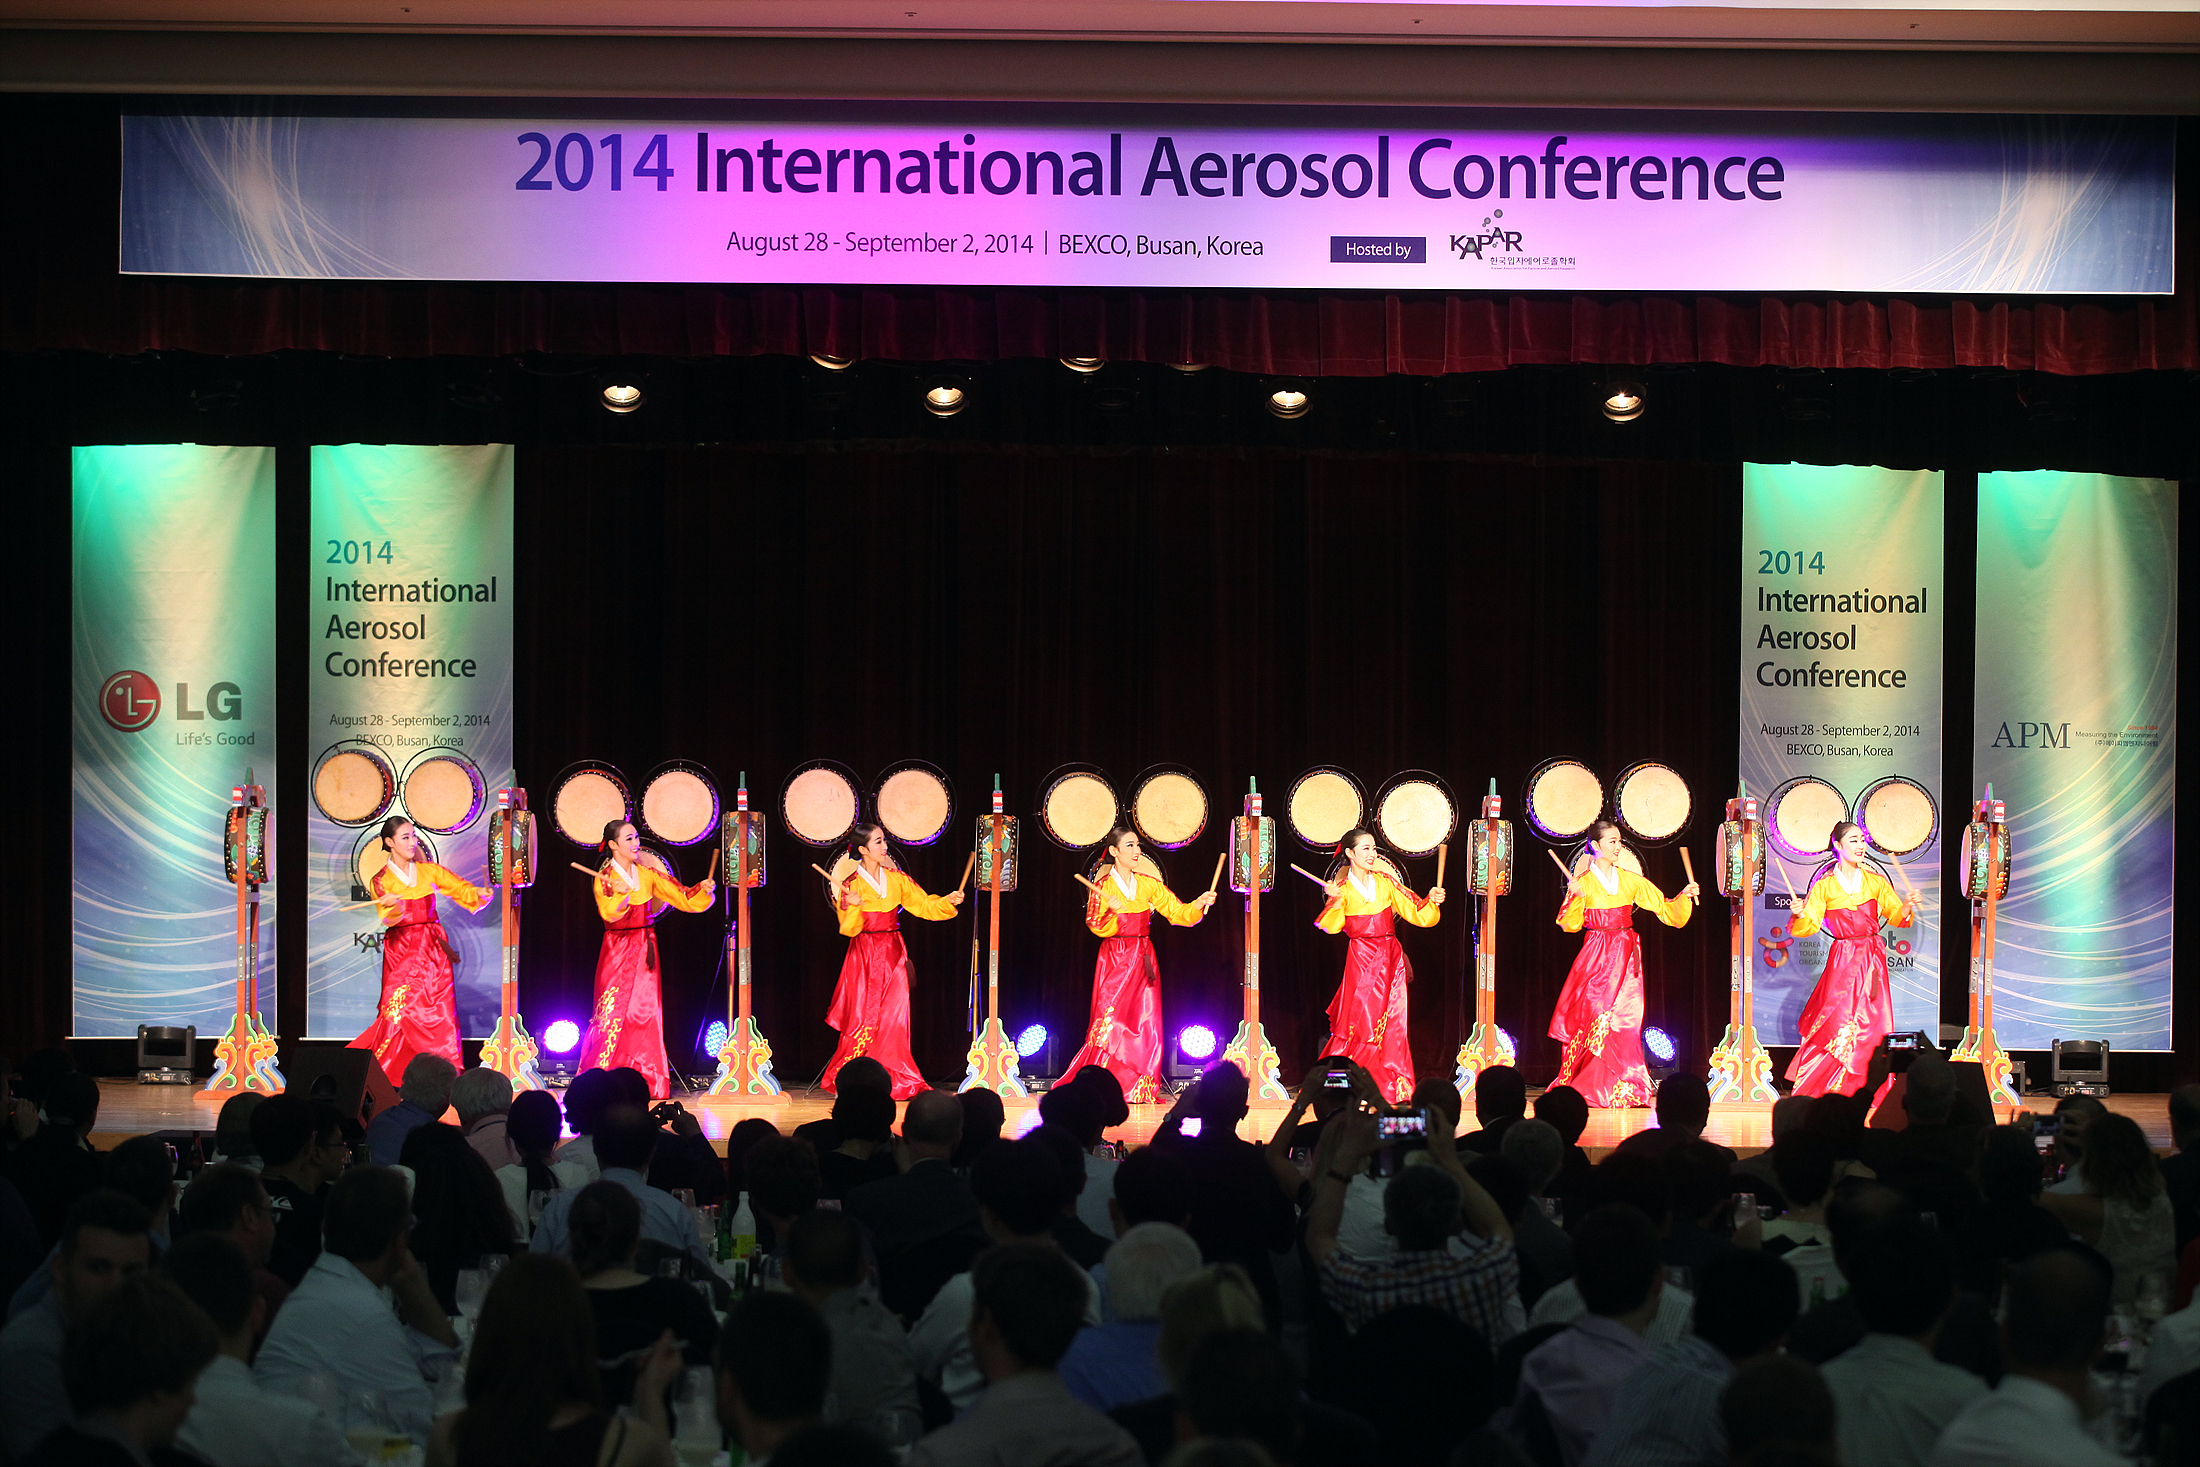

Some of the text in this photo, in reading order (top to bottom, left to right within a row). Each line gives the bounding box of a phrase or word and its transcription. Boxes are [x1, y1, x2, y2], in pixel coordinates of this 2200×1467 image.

[515, 132, 1785, 201] 2014 International Aerosol Conference
[726, 232, 799, 256] August
[804, 233, 828, 251] 28
[846, 232, 958, 256] September
[963, 234, 979, 256] 2,
[984, 234, 1034, 255] 2014
[1059, 234, 1132, 258] BEXCO,
[1136, 235, 1202, 258] Busan,
[1207, 236, 1264, 257] Korea
[1346, 242, 1412, 260] Hosted by
[1449, 226, 1524, 260] KAPAR
[326, 540, 394, 564] 2014
[1758, 550, 1826, 575] 2014
[327, 577, 497, 603] International
[1758, 587, 1927, 613] International
[325, 614, 426, 640] Aerosol
[1756, 624, 1856, 650] Aerosol
[325, 652, 477, 678] Conference
[1756, 661, 1907, 688] Conference
[176, 681, 242, 721] LG
[329, 714, 368, 728] August
[370, 714, 383, 725] 28
[392, 714, 451, 728] September
[453, 715, 462, 727] 2,
[464, 715, 490, 726] 2014
[1760, 723, 1799, 738] August
[1801, 724, 1814, 735] 28
[1822, 724, 1881, 738] September
[1882, 725, 1892, 738] 2,
[1894, 725, 1920, 737] 2014
[176, 732, 255, 745] Life's Good
[356, 734, 464, 748] BEXCO, Busan, Korea
[1991, 721, 2071, 749] APM
[2075, 731, 2107, 739] Measuring
[1786, 743, 1894, 757] BEXCO, Busan, Korea
